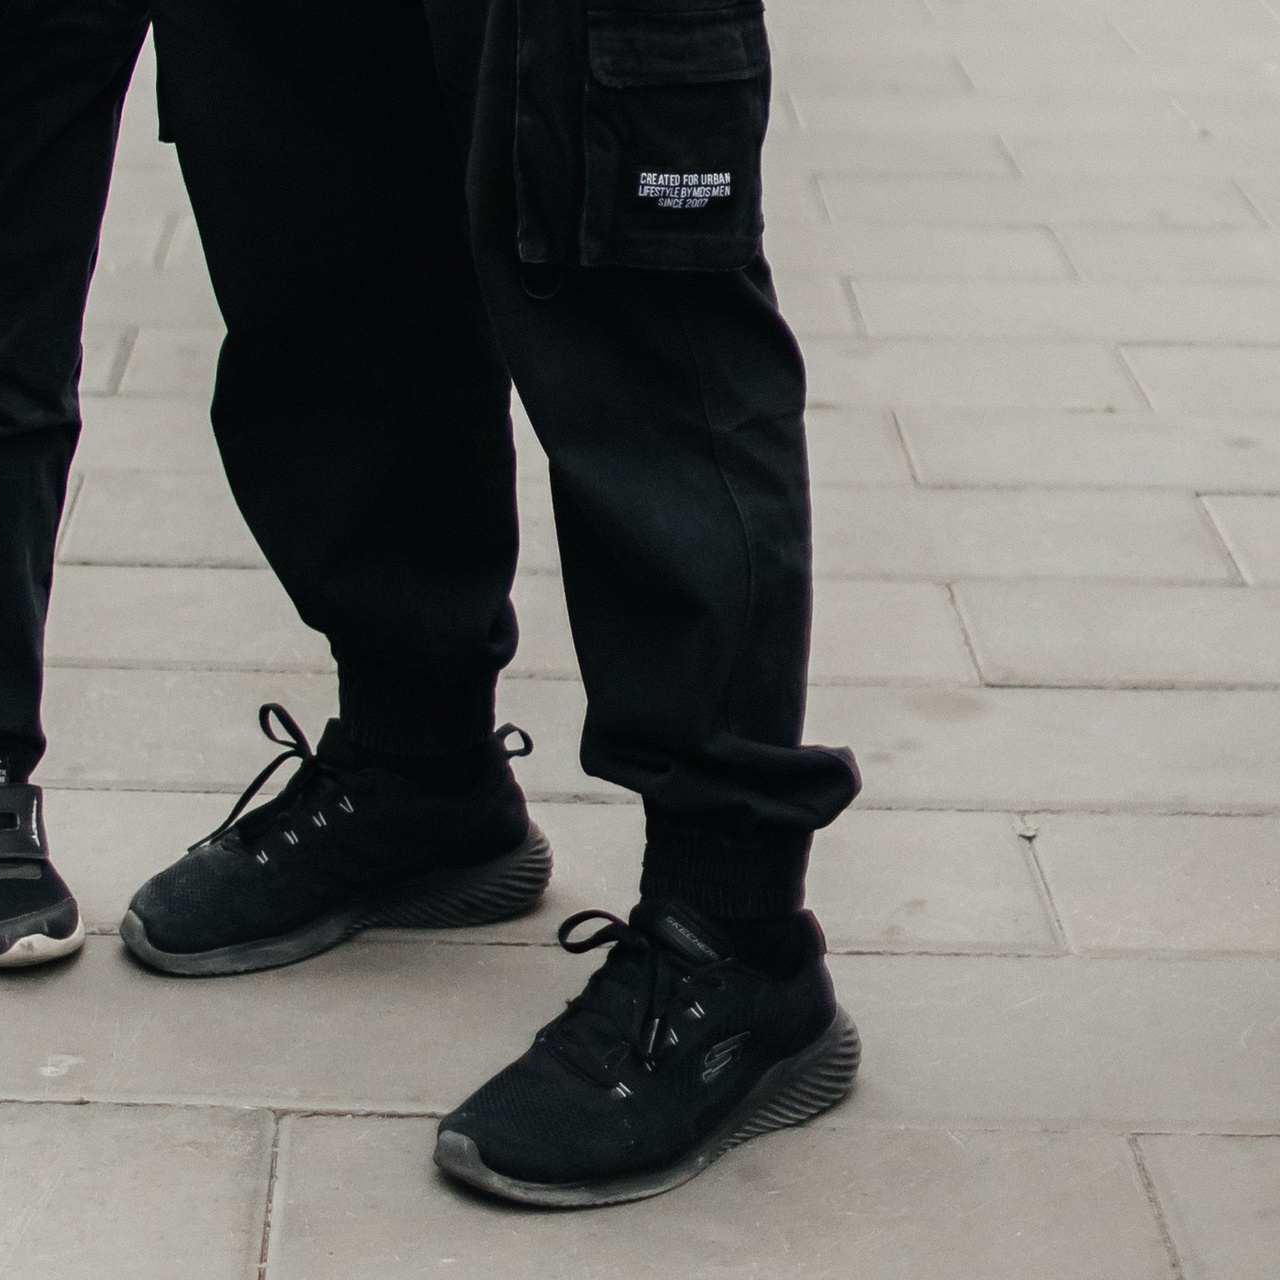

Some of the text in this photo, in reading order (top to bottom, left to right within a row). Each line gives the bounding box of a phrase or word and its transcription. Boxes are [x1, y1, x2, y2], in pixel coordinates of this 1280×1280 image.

[640, 172, 731, 186] CREATED FOR URBAN
[638, 185, 680, 198] LIFESTYLE
[680, 187, 693, 198] BY
[657, 198, 709, 208] SINCE 2007
